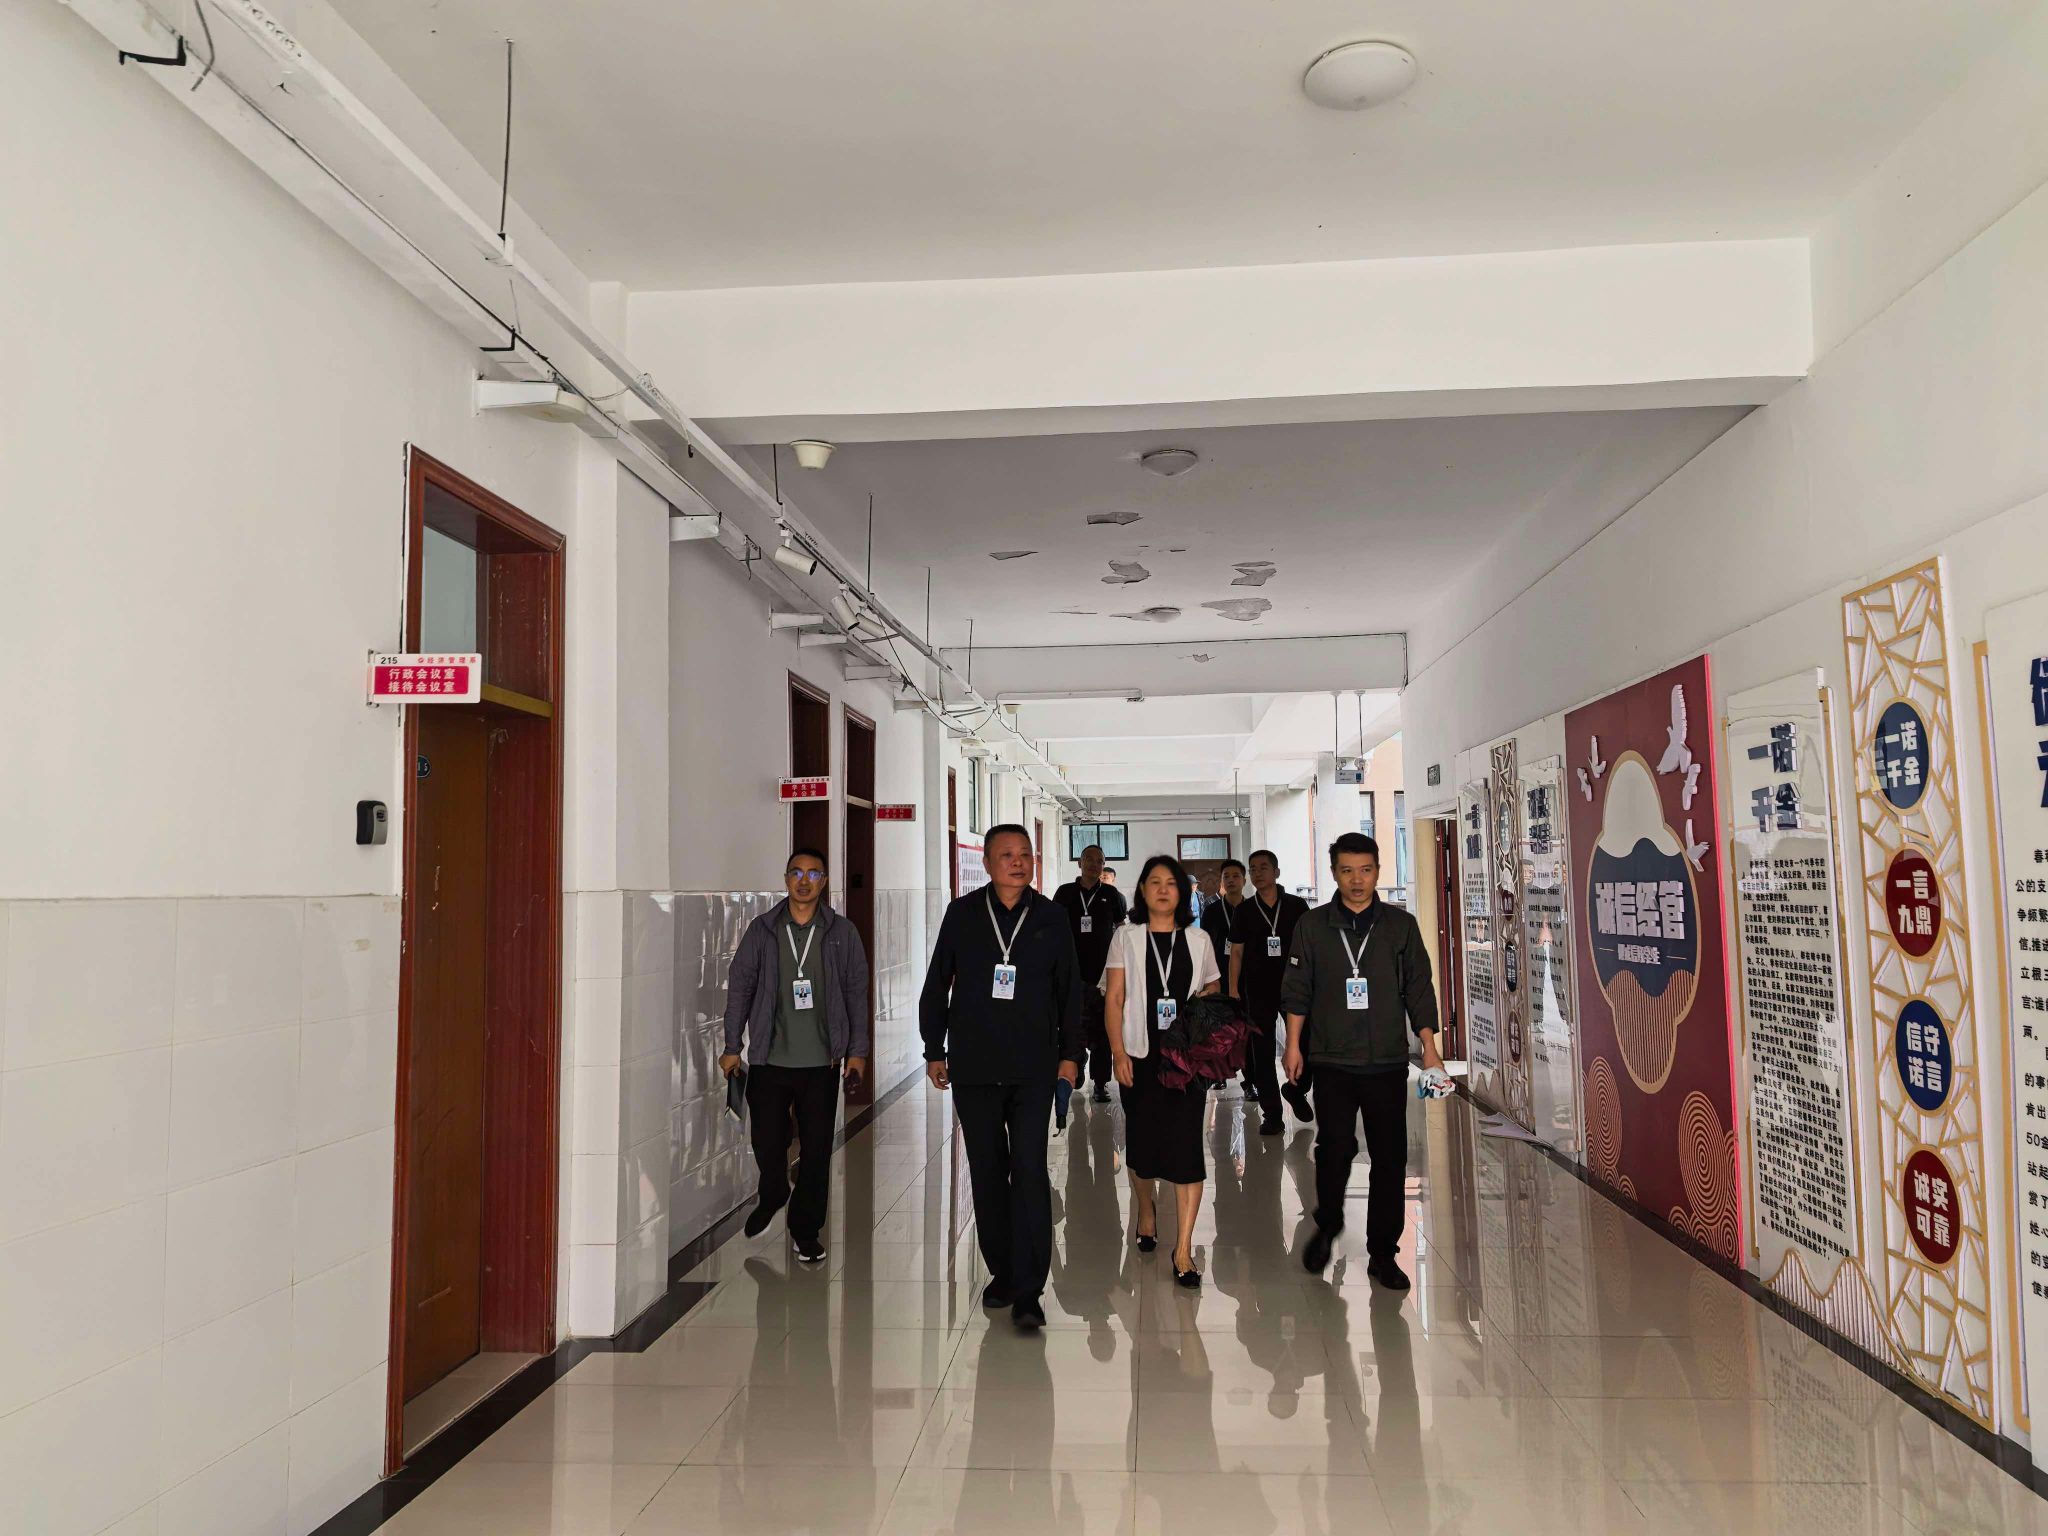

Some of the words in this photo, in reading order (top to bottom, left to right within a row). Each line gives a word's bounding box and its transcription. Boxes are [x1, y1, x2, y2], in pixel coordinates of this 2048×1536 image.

[388, 681, 455, 693] 接待会议室
[389, 668, 456, 679] 行政会议室
[1748, 722, 1798, 773] 一诺
[1884, 720, 1918, 750] 一诺
[1886, 756, 1920, 788] 千金
[1752, 782, 1801, 832] 千金
[1896, 870, 1929, 900] 一言
[2015, 878, 2047, 893] 公的支
[1595, 881, 1685, 939] 诚信经管
[1898, 903, 1932, 935] 九鼎
[1907, 1021, 1940, 1058] 信守
[1908, 1056, 1943, 1092] 诺言
[2026, 1103, 2047, 1119] 肯出
[2027, 1161, 2048, 1180] 站起
[1914, 1168, 1948, 1212] 诚实
[1915, 1205, 1950, 1248] 可靠
